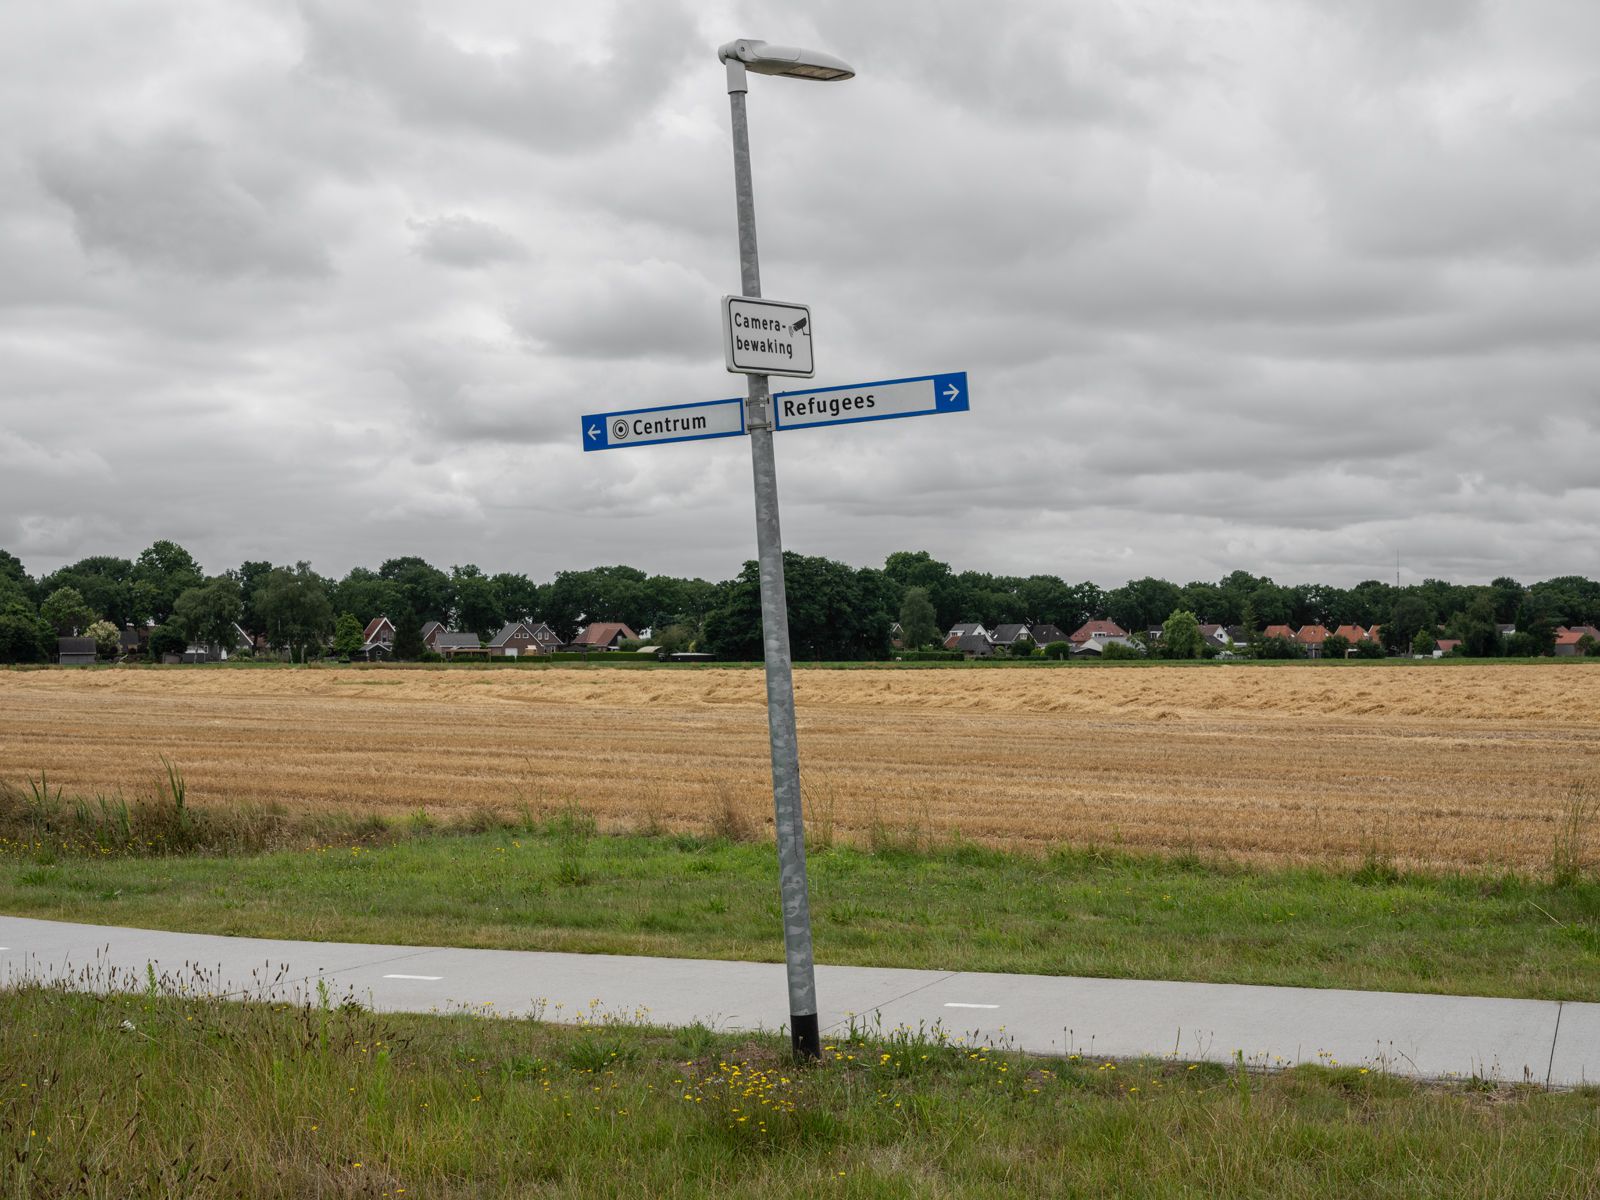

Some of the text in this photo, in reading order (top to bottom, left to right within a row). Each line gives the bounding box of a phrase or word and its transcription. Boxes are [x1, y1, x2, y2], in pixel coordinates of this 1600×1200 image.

[734, 312, 786, 332] Camera-
[736, 335, 793, 360] bewaking
[783, 393, 876, 417] Refugees
[633, 413, 707, 436] Centrum
